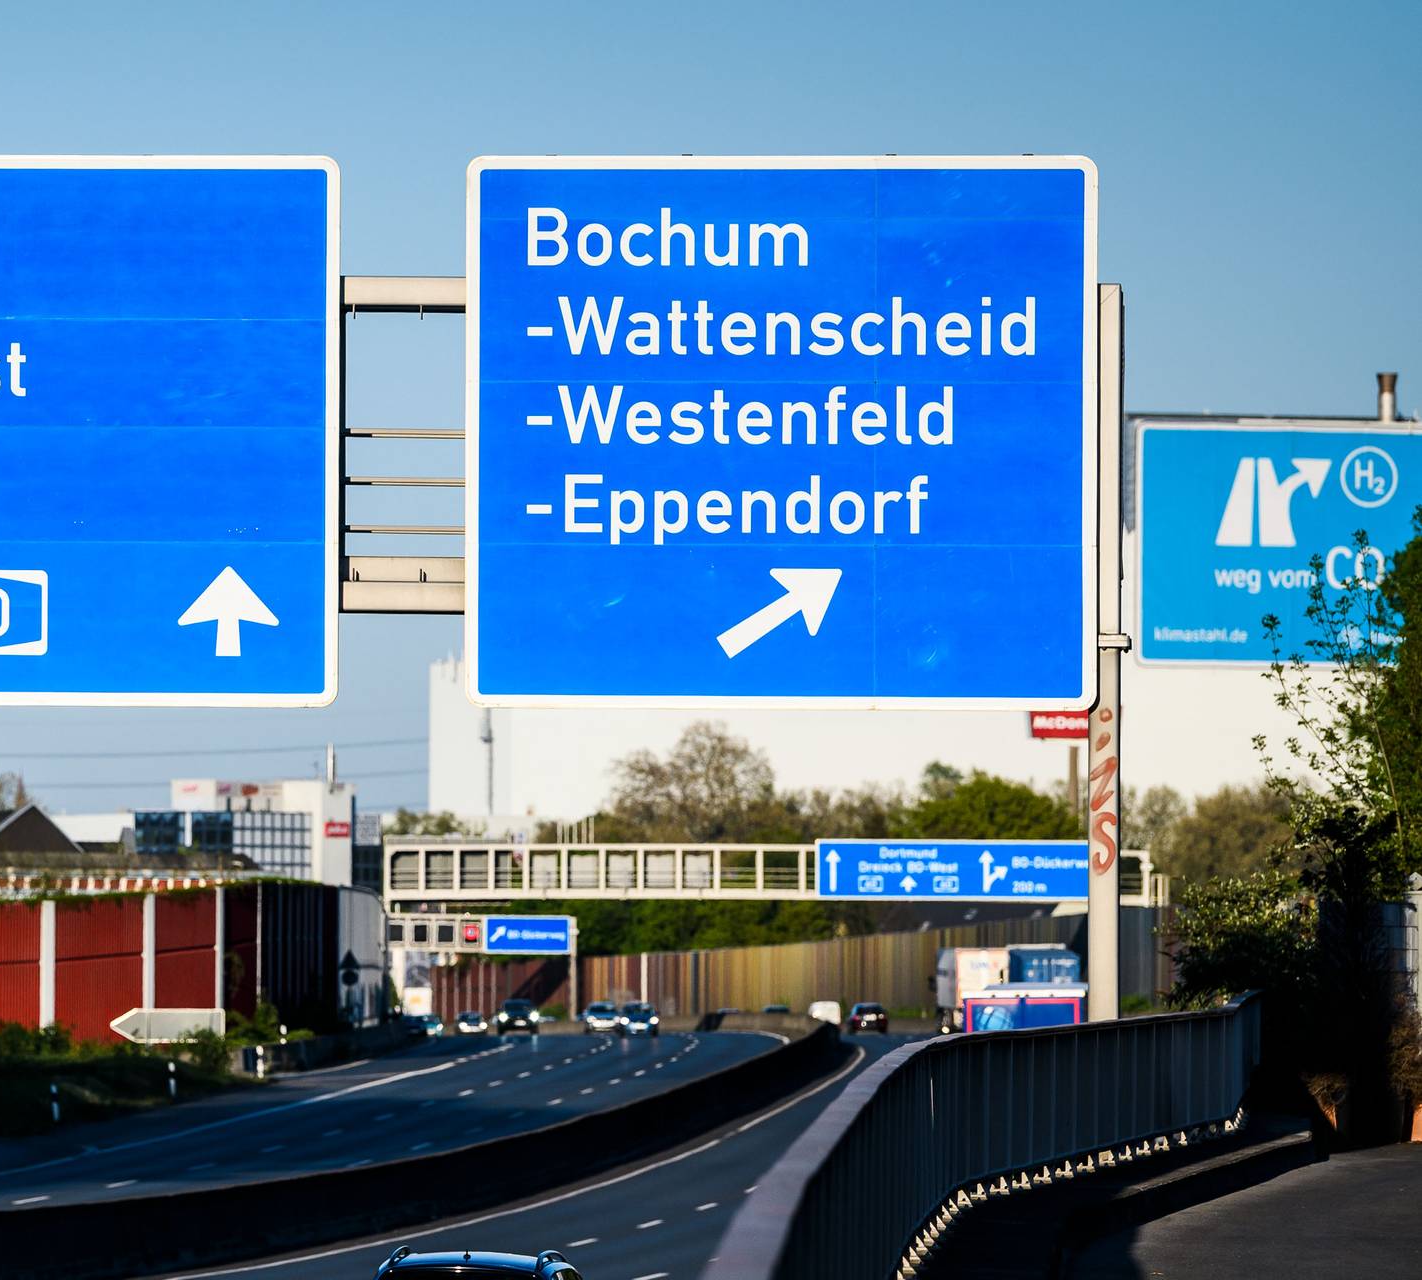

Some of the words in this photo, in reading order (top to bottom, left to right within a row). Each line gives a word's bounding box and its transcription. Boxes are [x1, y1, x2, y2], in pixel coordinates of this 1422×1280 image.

[526, 207, 809, 267] Bochum
[526, 296, 1036, 356] -Wattenscheid
[526, 385, 954, 446] -Westenfeld
[526, 473, 929, 546] -Eppendorf
[1214, 568, 1262, 594] weg
[1267, 568, 1318, 589] vom
[1153, 626, 1249, 644] klimastahl.de
[858, 860, 903, 874] Dreieck
[906, 860, 959, 874] BO-West
[879, 846, 938, 859] Dortmund
